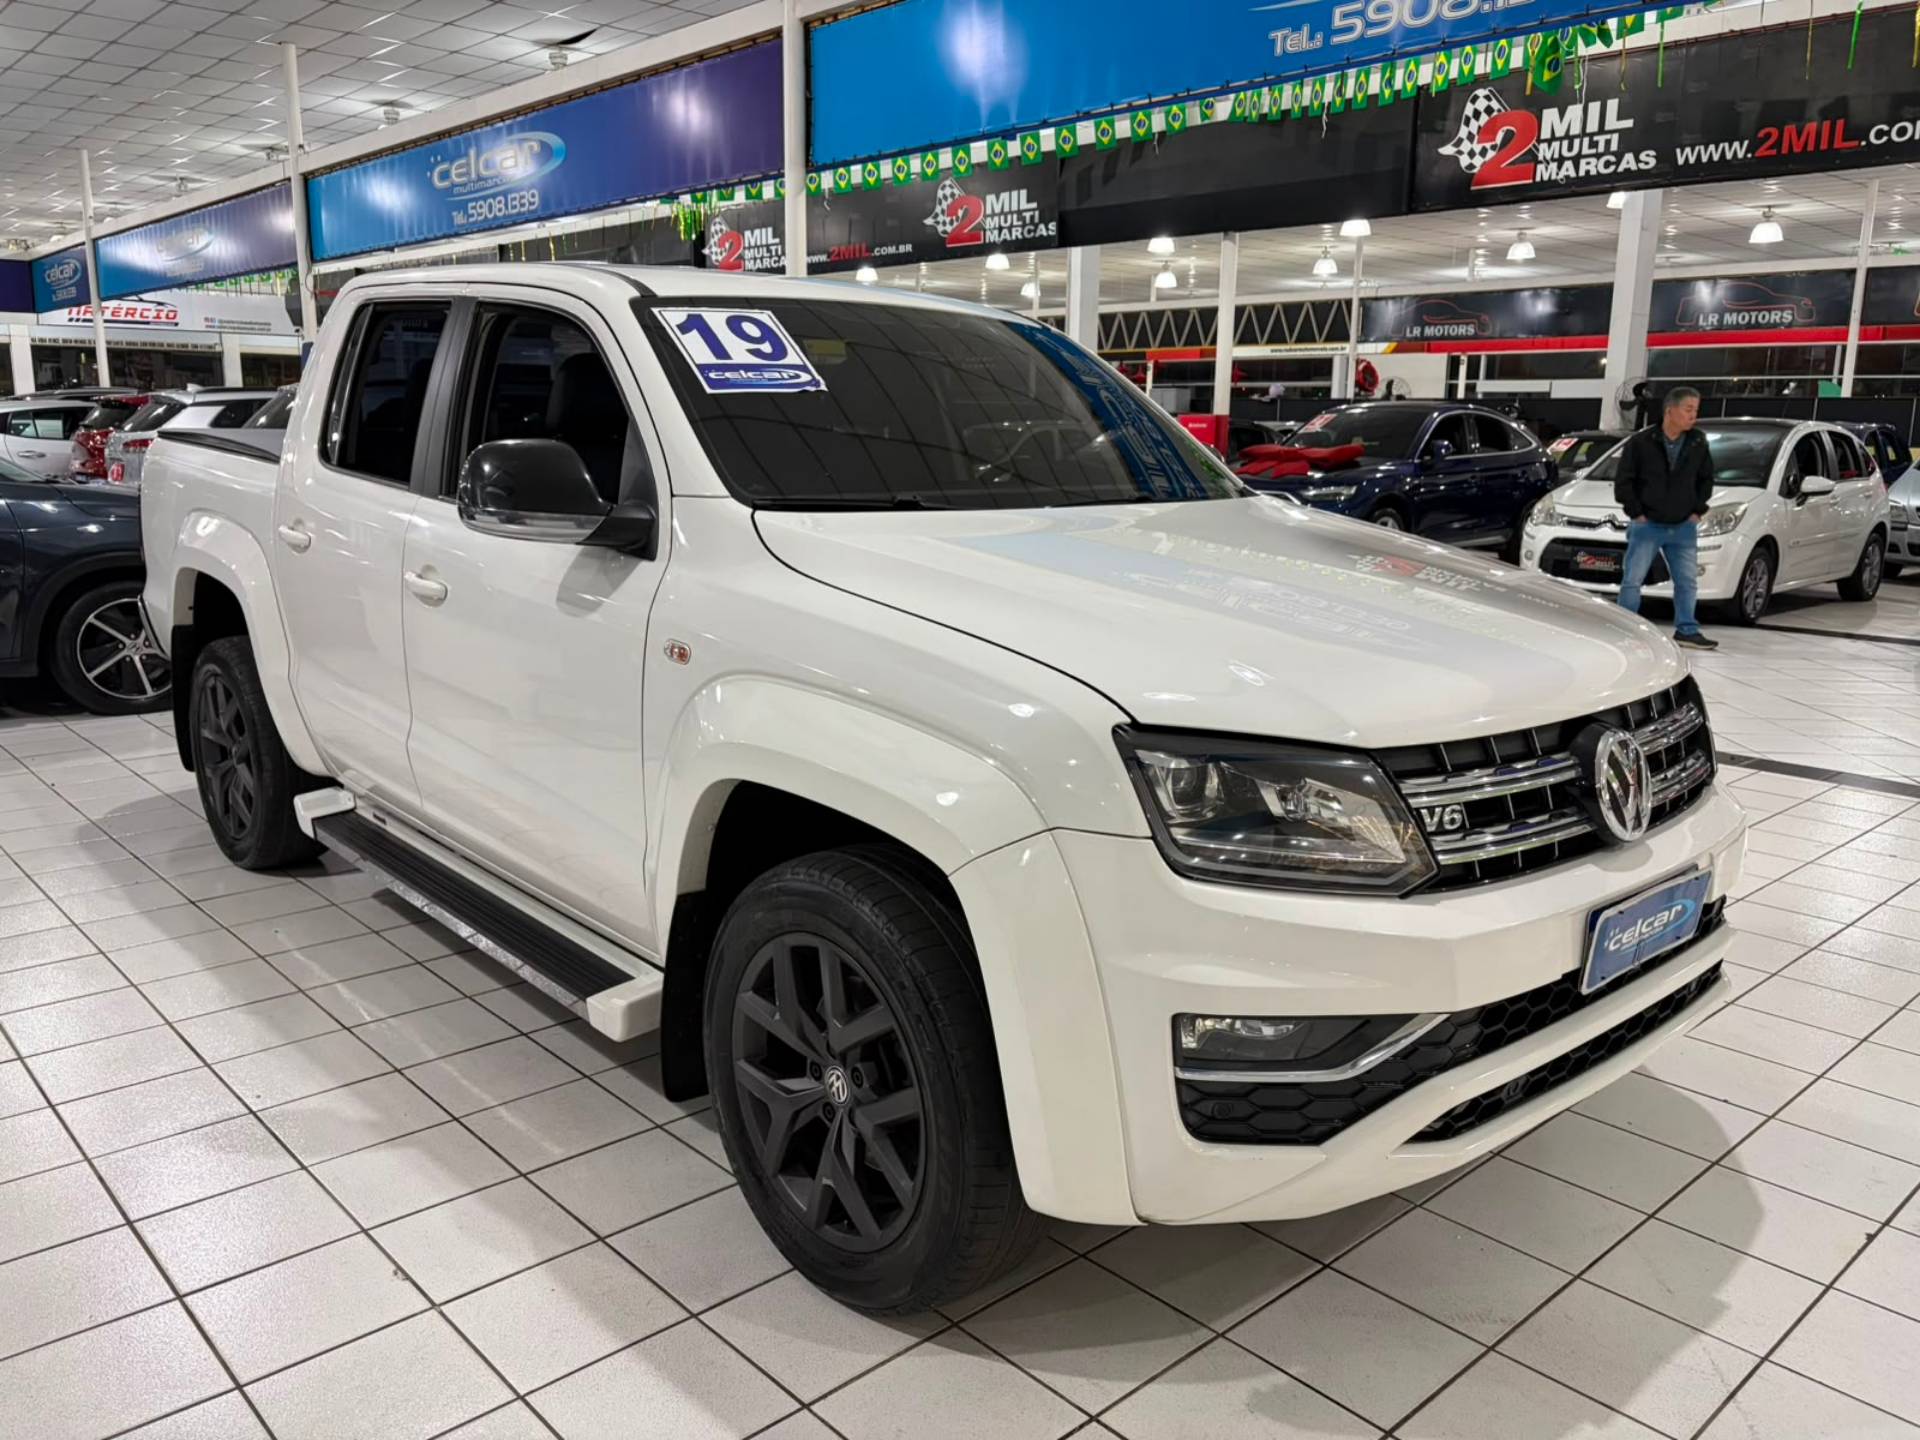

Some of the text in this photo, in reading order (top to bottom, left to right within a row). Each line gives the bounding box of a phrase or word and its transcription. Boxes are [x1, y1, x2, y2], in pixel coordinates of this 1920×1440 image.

[1330, 0, 1537, 45] 590.
[1540, 98, 1634, 140] MIL
[1470, 110, 1538, 190] 2
[1537, 133, 1619, 162] MULTI
[432, 139, 542, 189] celcar
[1535, 150, 1657, 183] MARCAS
[468, 189, 539, 222] 5908.1339
[986, 188, 1038, 215] MIL
[946, 194, 984, 247] 2
[985, 210, 1039, 230] MULTI
[985, 221, 1057, 244] MARCAS
[719, 230, 744, 272] 2
[744, 226, 780, 248] MIL
[744, 244, 782, 260] MULTI
[744, 256, 787, 271] MARCA
[1406, 323, 1475, 337] LR MOTORS
[1698, 309, 1793, 326] LR MOTORS
[676, 313, 788, 362] 19
[1421, 804, 1463, 832] V6
[1608, 904, 1683, 952] celcar
